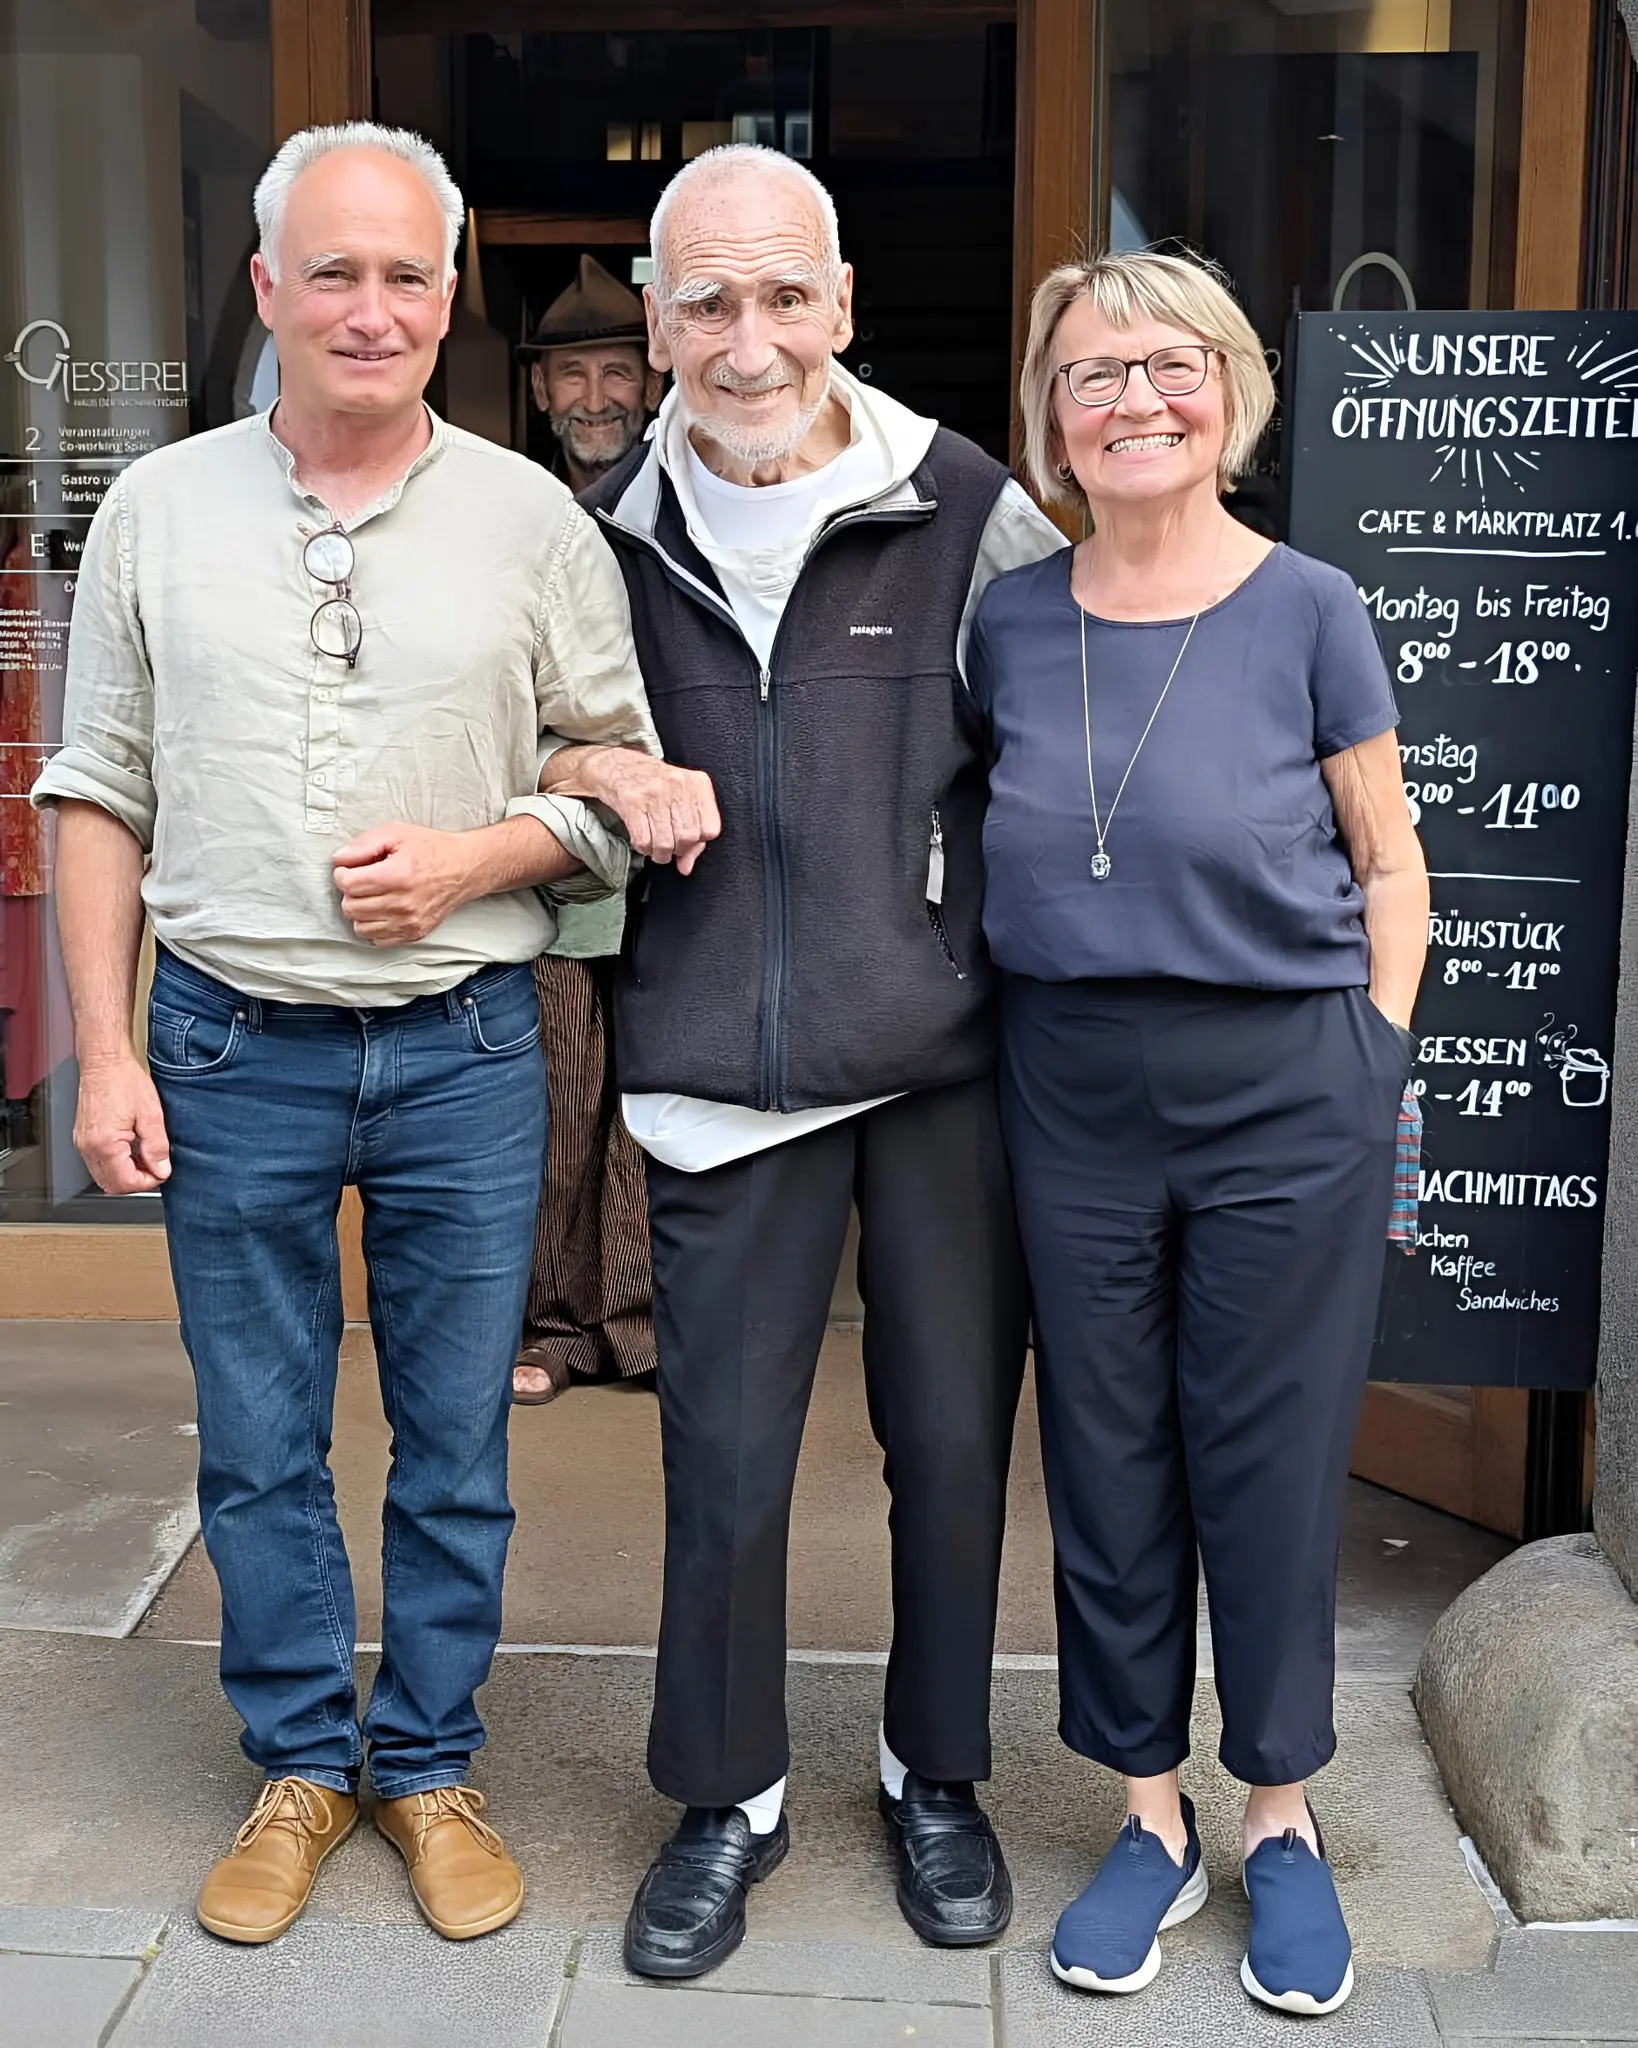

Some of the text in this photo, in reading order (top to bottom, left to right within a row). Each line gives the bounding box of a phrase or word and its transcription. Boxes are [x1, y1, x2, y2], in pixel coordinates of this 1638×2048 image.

[1408, 333, 1555, 377] UNSERE
[25, 427, 41, 451] 2
[28, 479, 38, 504] 1
[61, 474, 100, 486] Gastro
[61, 490, 106, 505] Marktp
[1358, 510, 1638, 541] CAFE & MARKTPLATZ 1.
[31, 533, 45, 558] E
[1358, 584, 1610, 638] Montag bis Freitag
[1398, 733, 1478, 784] mstag
[1428, 907, 1565, 952] RÜHSTÜCK
[1418, 1036, 1527, 1067] GESSEN
[1430, 1254, 1497, 1287] Kaffee
[1456, 1287, 1560, 1313] Sandwiches
